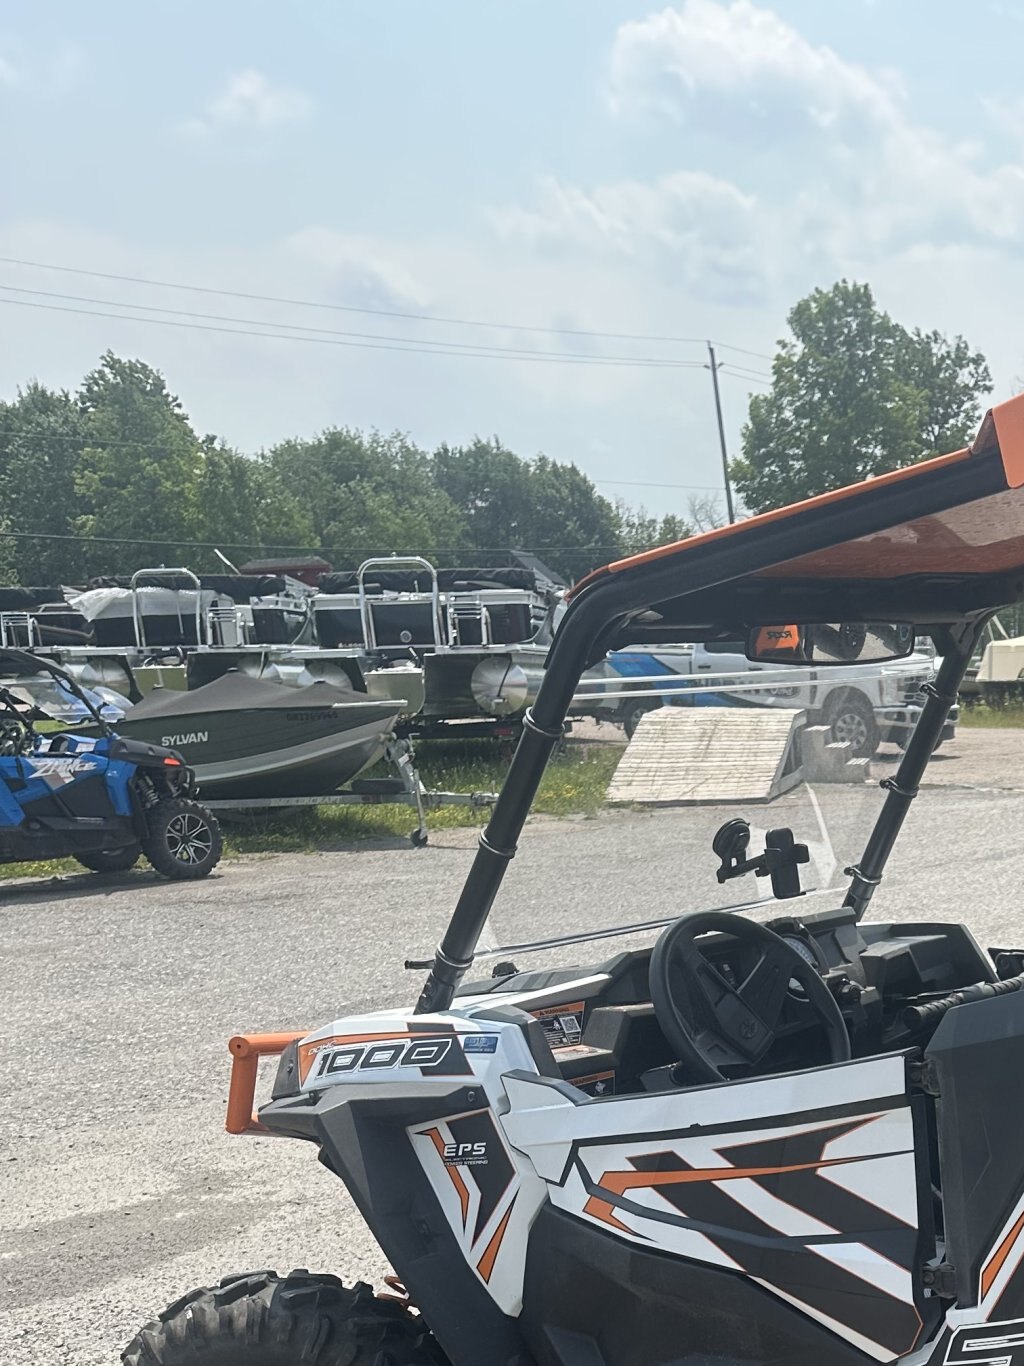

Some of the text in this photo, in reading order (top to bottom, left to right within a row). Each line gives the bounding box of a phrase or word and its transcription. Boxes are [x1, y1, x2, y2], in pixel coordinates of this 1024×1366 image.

[161, 731, 209, 747] SYLVAN
[315, 1038, 452, 1080] 1000
[443, 1142, 487, 1157] EPS
